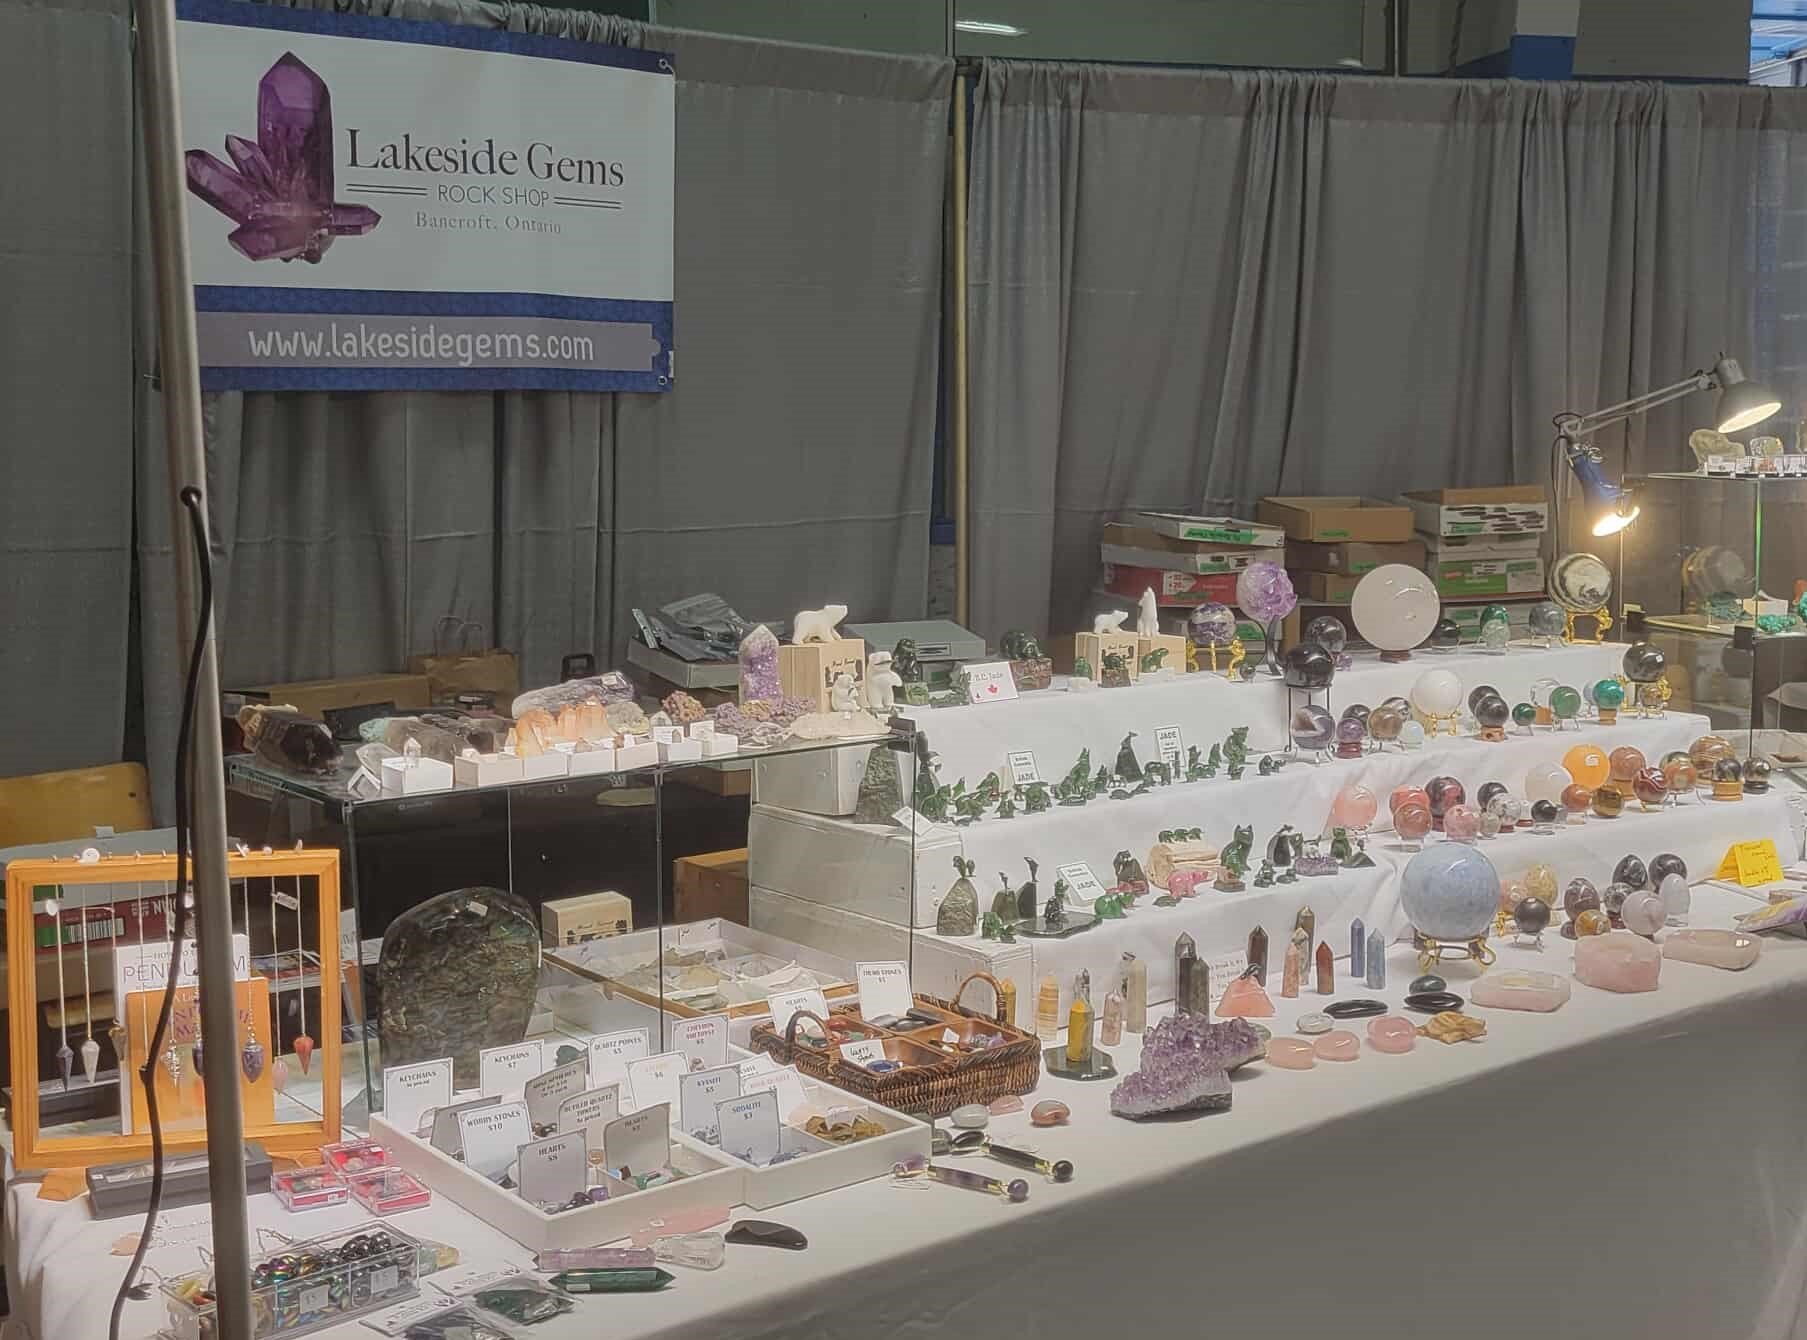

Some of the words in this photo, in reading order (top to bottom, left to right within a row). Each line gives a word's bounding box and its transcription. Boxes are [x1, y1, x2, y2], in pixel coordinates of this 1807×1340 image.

[346, 128, 518, 176] Lakeside
[527, 142, 625, 187] Gems
[437, 184, 497, 205] ROCK
[502, 186, 550, 208] SHOP
[416, 211, 497, 231] Bancroft,
[505, 215, 562, 235] Ontario
[248, 321, 594, 367] www.lakesidegems.com
[1159, 730, 1177, 740] JADE
[1018, 772, 1035, 782] JADE
[494, 1051, 530, 1063] KEYCHAINS
[399, 1071, 437, 1083] KEYCHAINS
[732, 1101, 761, 1113] SODALITE
[467, 1116, 493, 1128] WORRY
[494, 1110, 521, 1121] STONES
[538, 1144, 567, 1156] HEARTS
